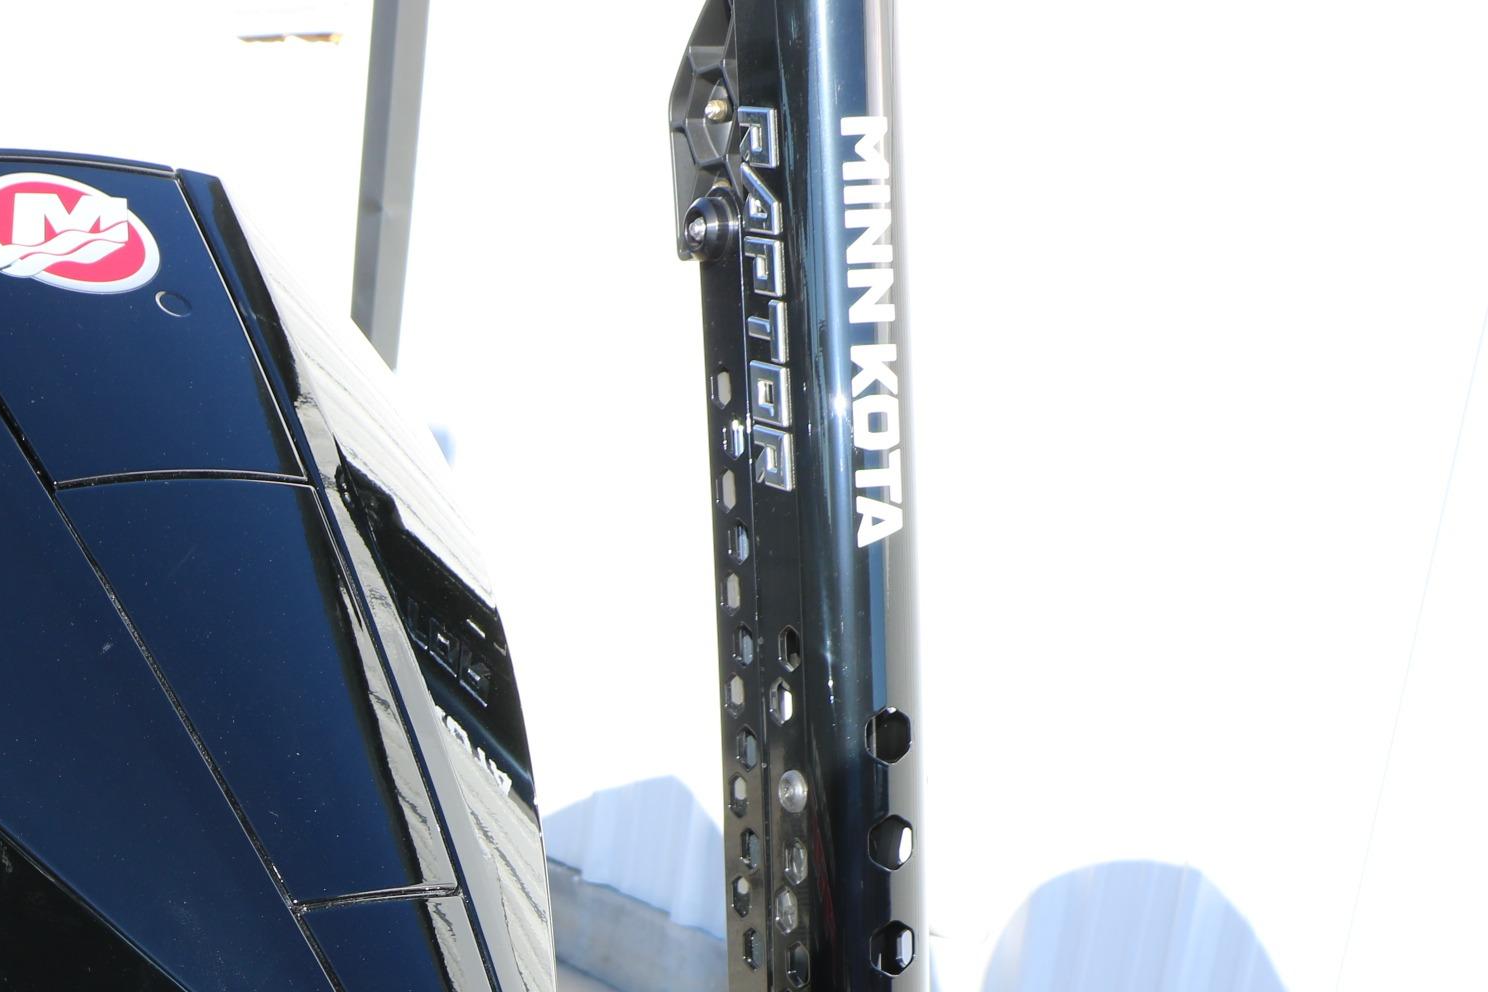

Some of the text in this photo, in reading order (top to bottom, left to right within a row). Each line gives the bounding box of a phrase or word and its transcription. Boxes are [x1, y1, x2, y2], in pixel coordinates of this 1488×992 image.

[738, 106, 793, 491] RAPTOR
[840, 116, 903, 548] MINN KOTA
